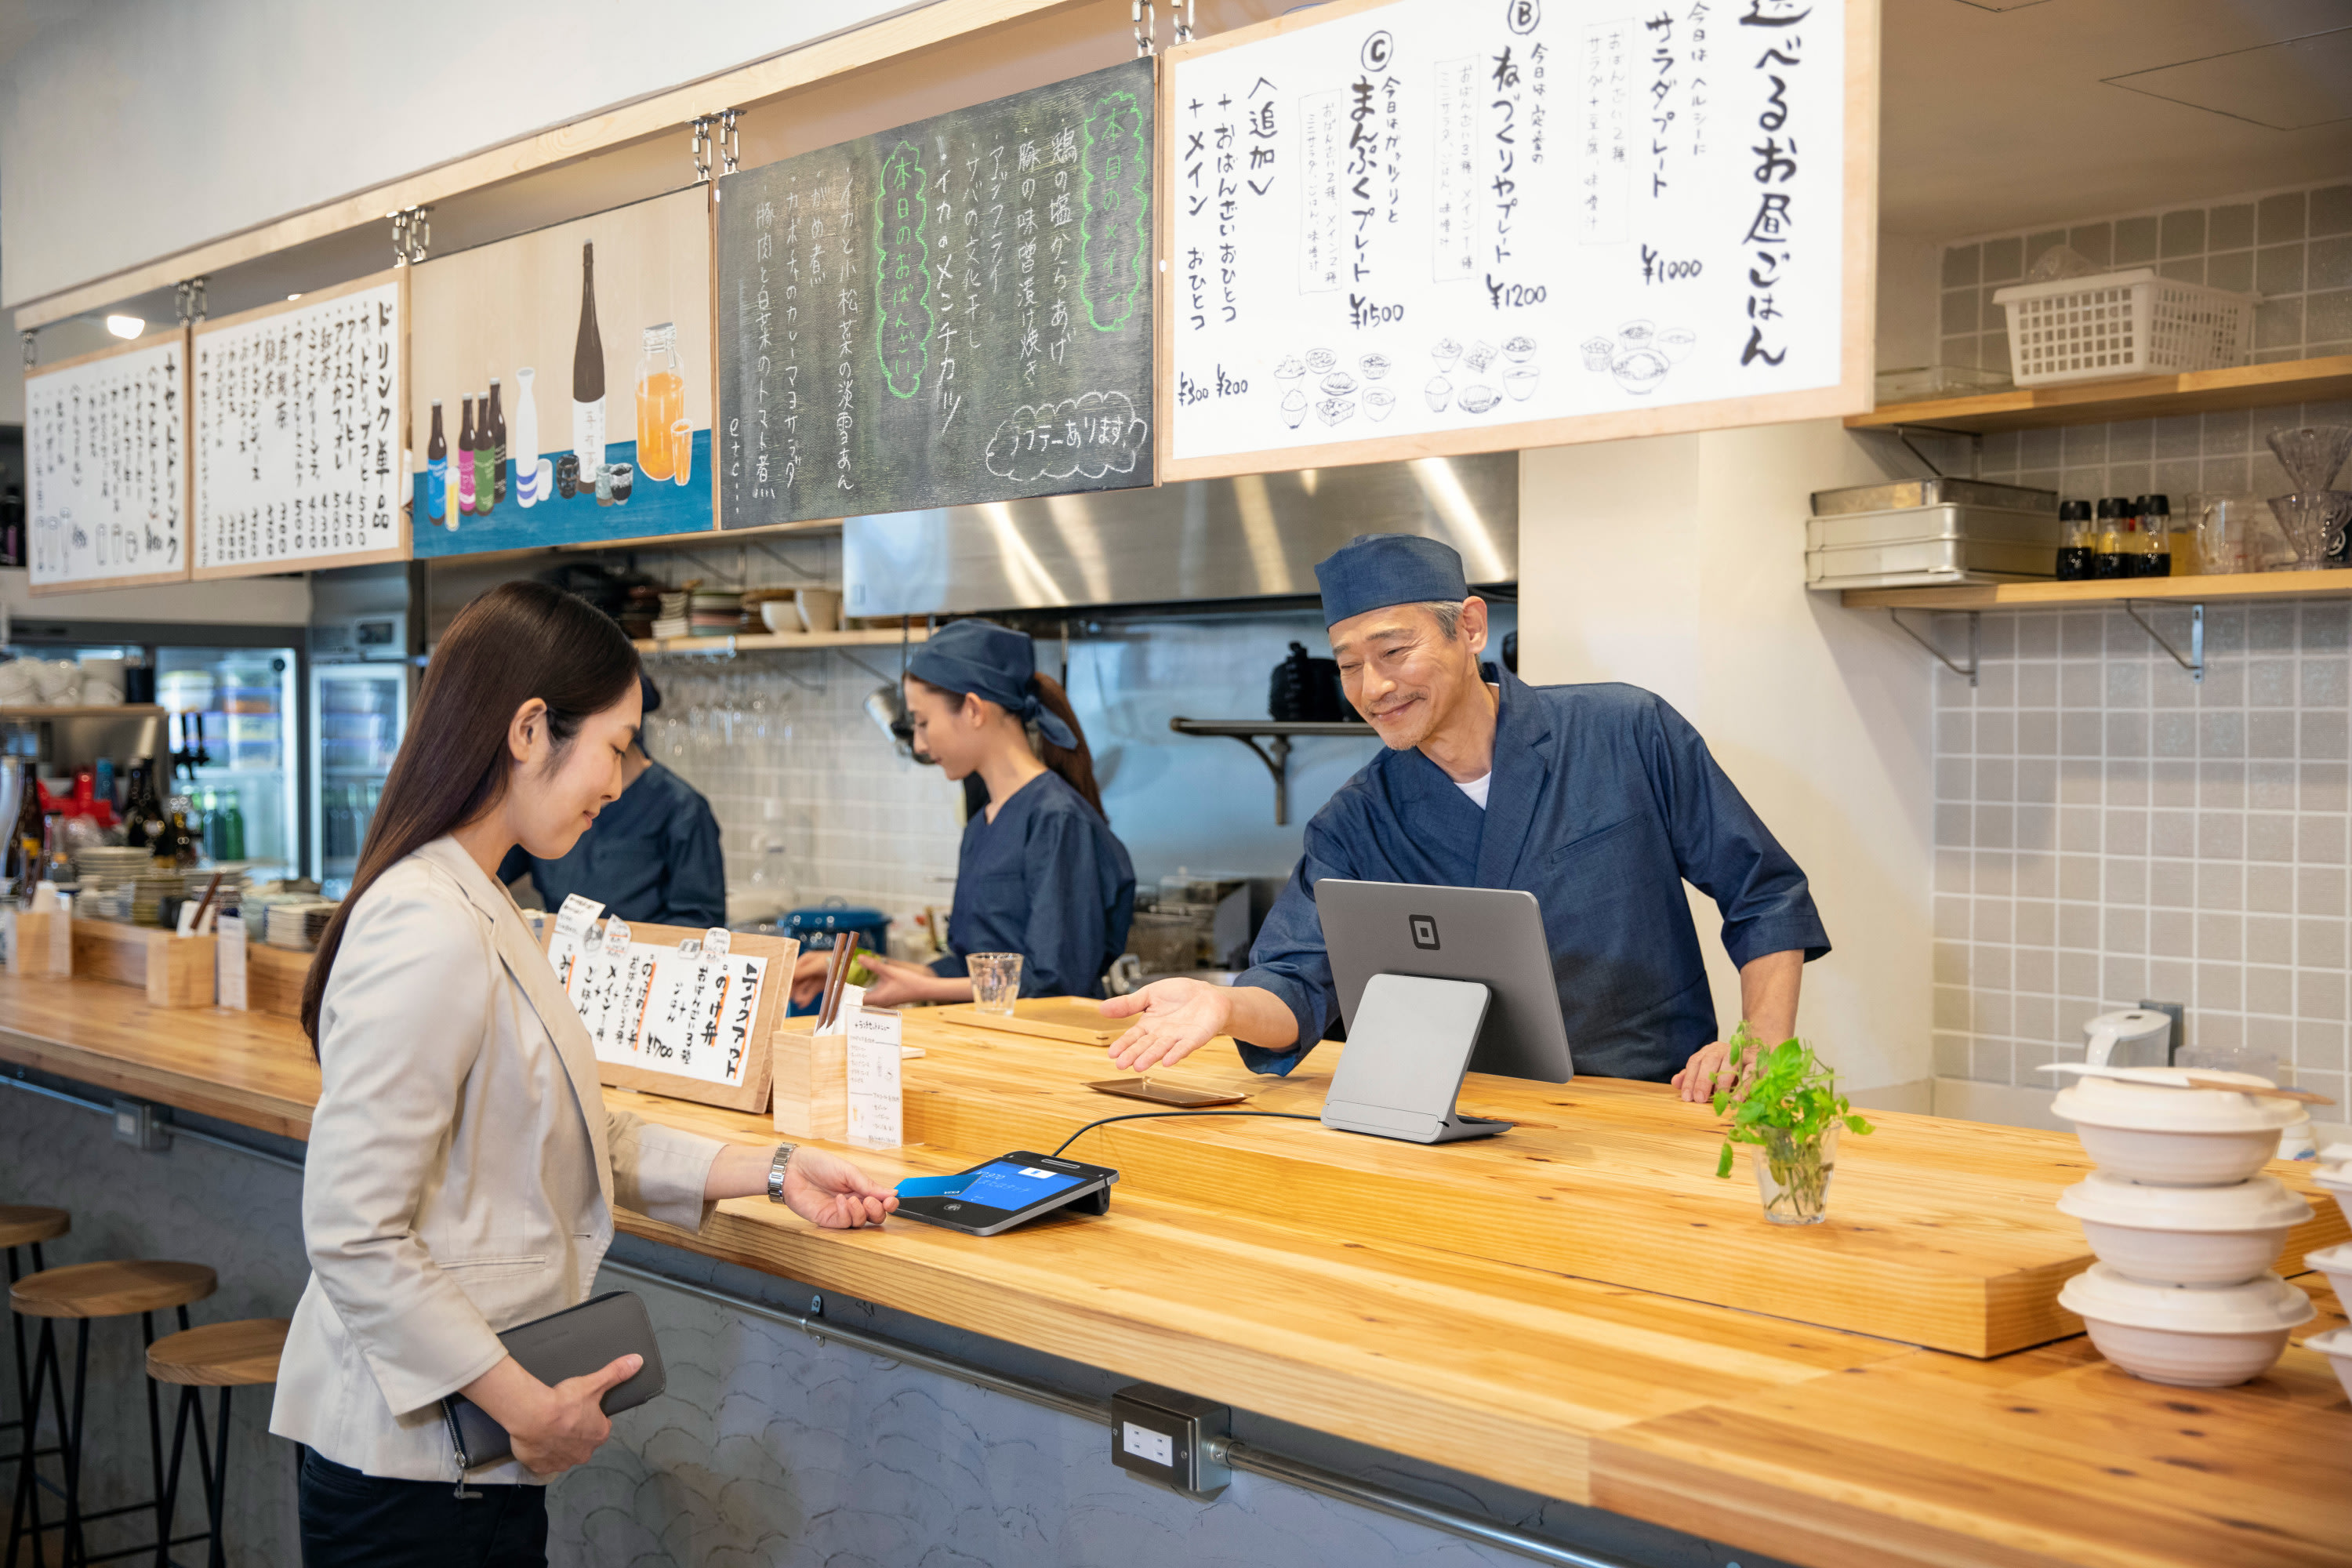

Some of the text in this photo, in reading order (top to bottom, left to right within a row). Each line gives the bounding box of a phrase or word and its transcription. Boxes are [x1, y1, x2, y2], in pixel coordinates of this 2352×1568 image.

[1646, 11, 1677, 198] サラダプレート
[1102, 108, 1127, 303] 本日のメイン
[1347, 74, 1378, 283] まんぷくプレート
[893, 160, 915, 375] 本日のおばんざい
[1349, 293, 1404, 329] ¥1500
[1486, 273, 1547, 310] ¥1200
[1642, 244, 1702, 285] ¥1000
[373, 301, 392, 529] ドリンク単品
[1178, 371, 1209, 407] ¥300
[1216, 363, 1249, 398] ¥200
